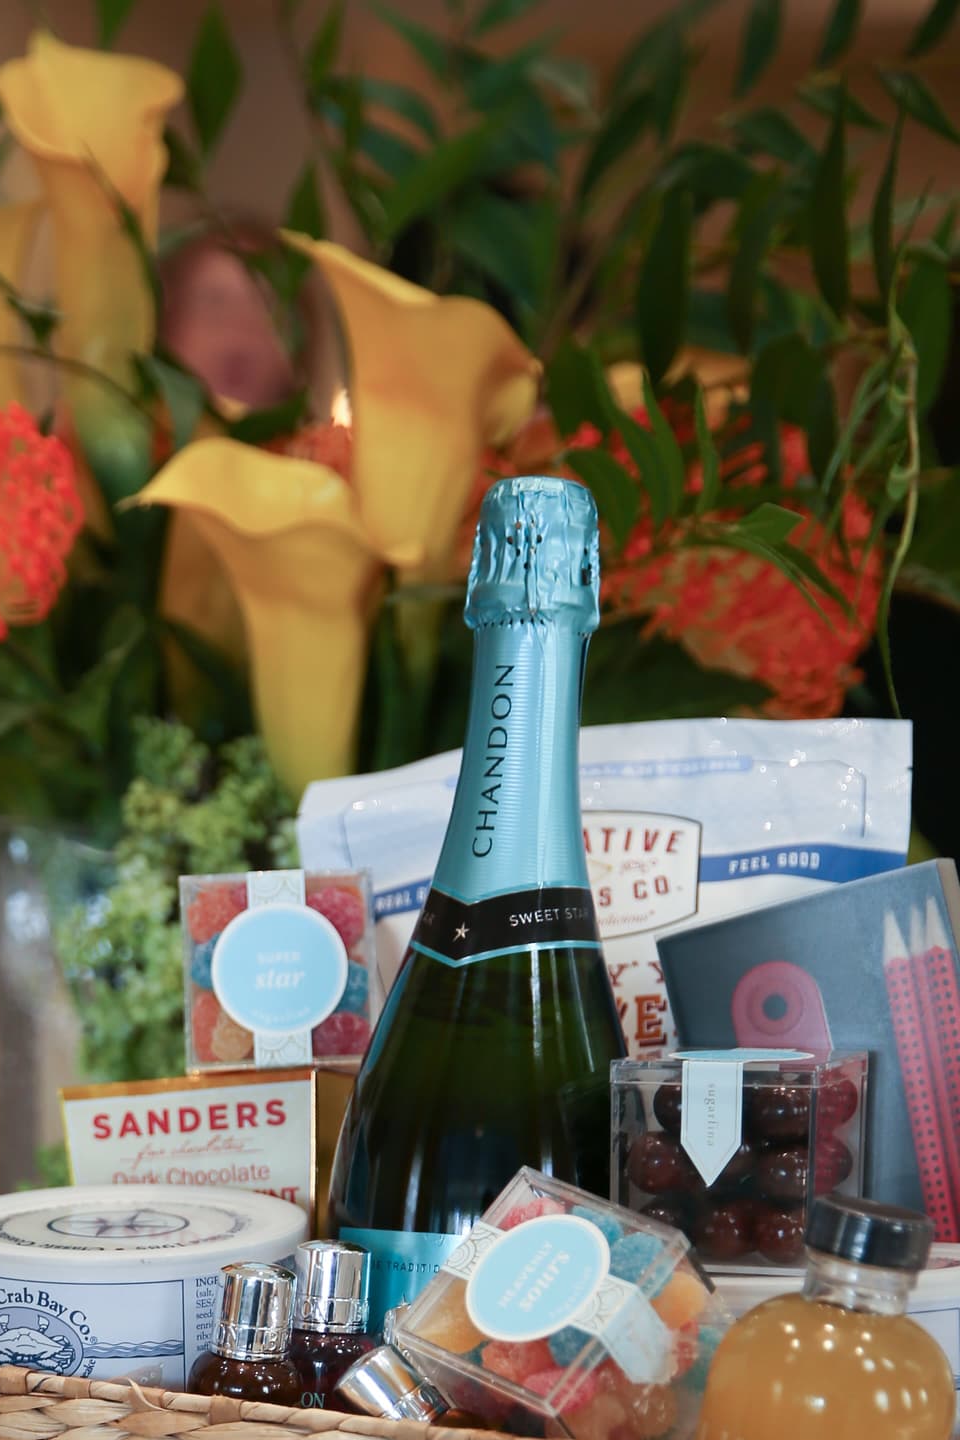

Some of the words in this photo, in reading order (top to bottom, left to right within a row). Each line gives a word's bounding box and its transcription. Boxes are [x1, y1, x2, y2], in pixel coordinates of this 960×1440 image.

[472, 665, 515, 857] CHANDON
[728, 855, 771, 875] FEEL
[777, 851, 820, 870] GOOD
[509, 908, 560, 927] SWEET
[256, 968, 305, 990] star
[93, 1098, 288, 1141] SANDERS
[166, 1163, 271, 1186] Chocolate
[36, 1290, 68, 1318] Bay
[69, 1310, 90, 1341] Co.
[302, 1391, 327, 1410] ON
